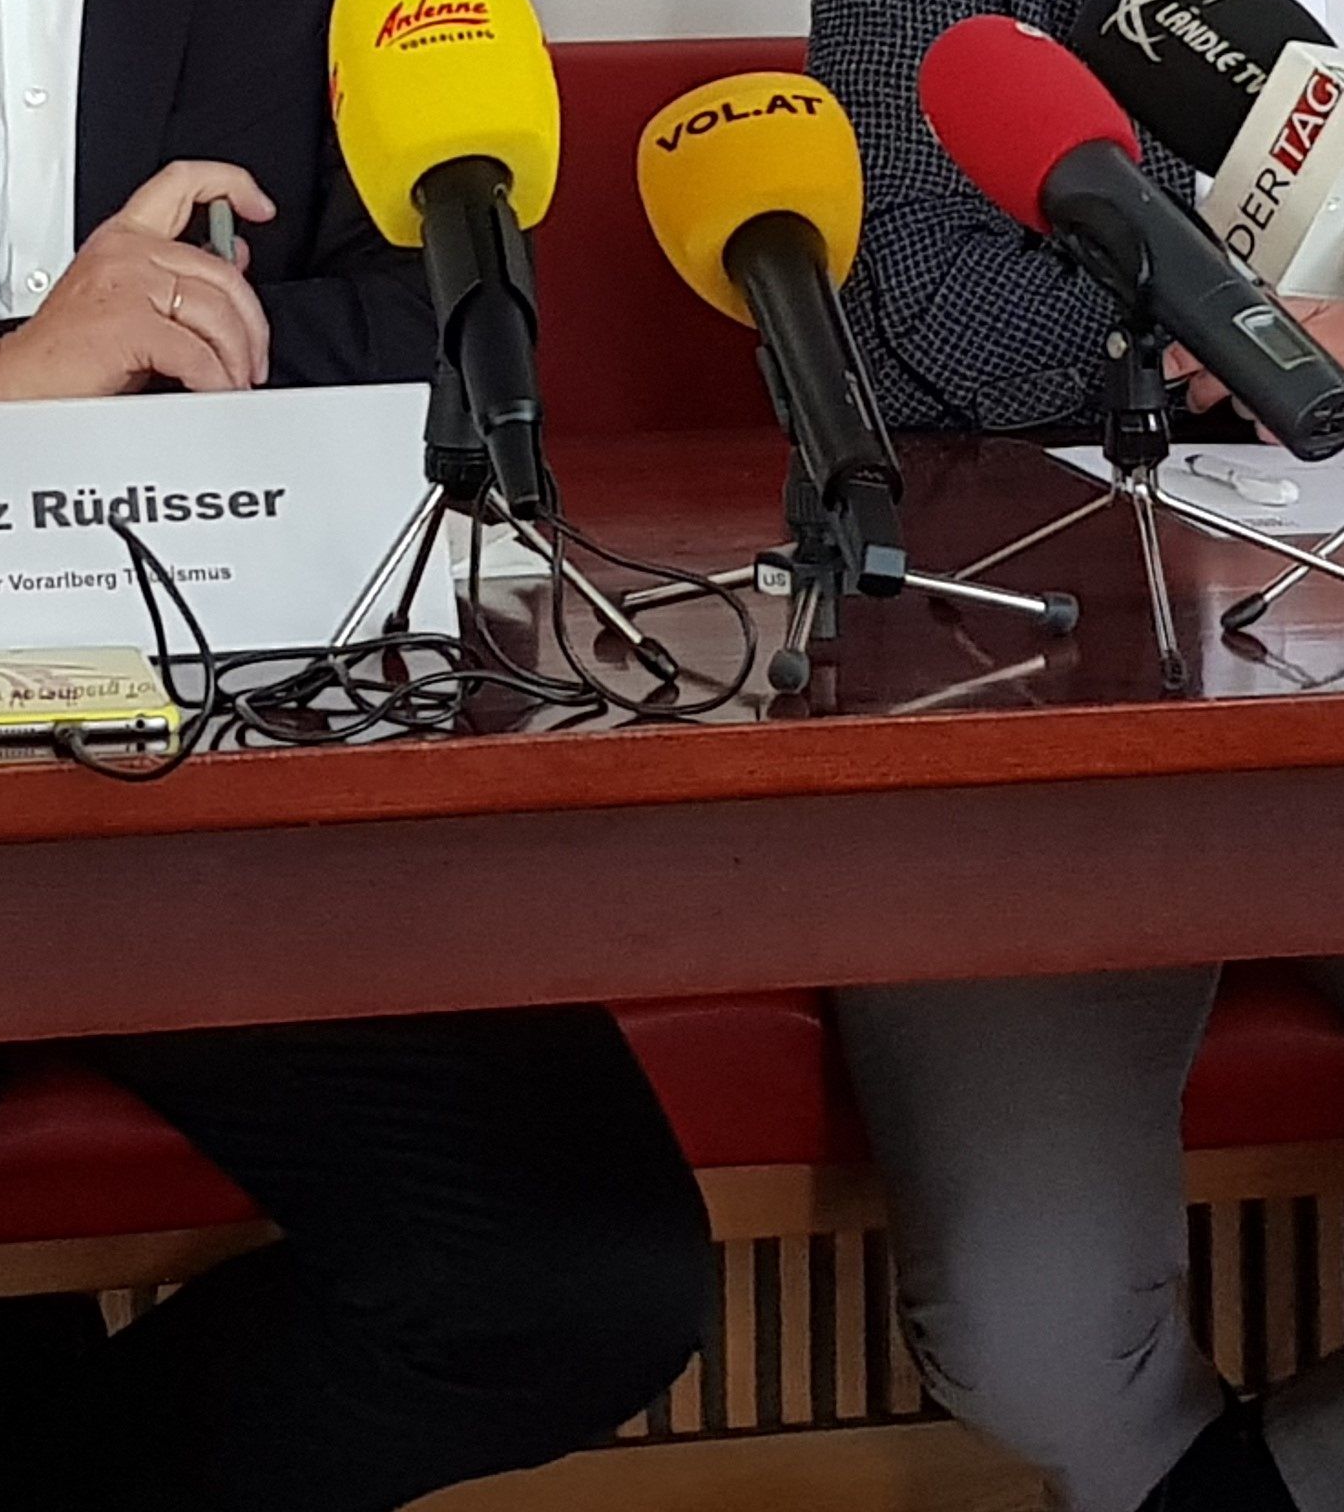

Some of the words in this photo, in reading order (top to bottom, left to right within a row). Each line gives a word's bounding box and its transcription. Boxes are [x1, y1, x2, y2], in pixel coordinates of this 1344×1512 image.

[1155, 1, 1246, 72] LÄNDLE
[656, 94, 823, 152] VOL.AT
[1225, 167, 1291, 264] DER
[1272, 73, 1342, 162] TAG
[31, 485, 286, 528] Rüdisser
[8, 569, 117, 590] Vorarlberg
